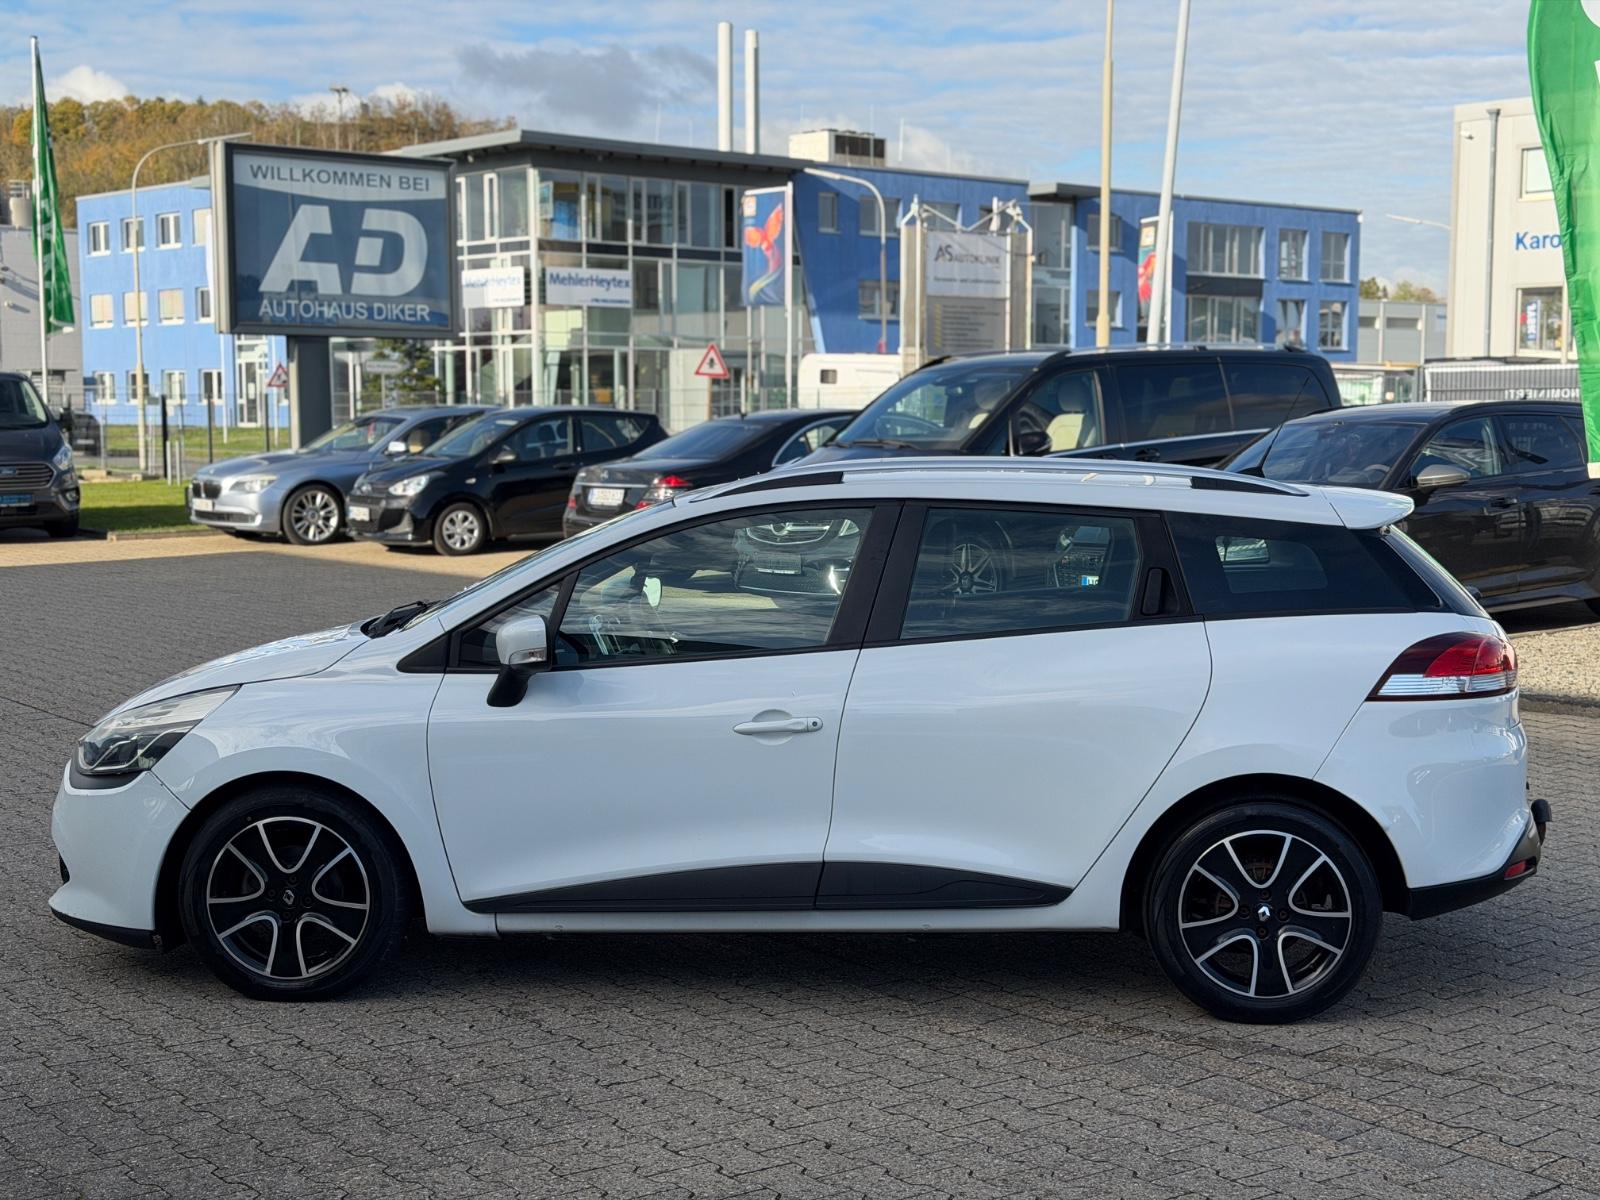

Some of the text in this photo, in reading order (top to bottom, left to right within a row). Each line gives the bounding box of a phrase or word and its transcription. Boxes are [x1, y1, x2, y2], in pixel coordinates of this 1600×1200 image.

[250, 164, 430, 192] WILLKOMMEN BEI
[258, 204, 429, 297] AD
[549, 272, 630, 292] MehlerHeytex
[258, 299, 431, 321] AUTOHAUS DIKER
